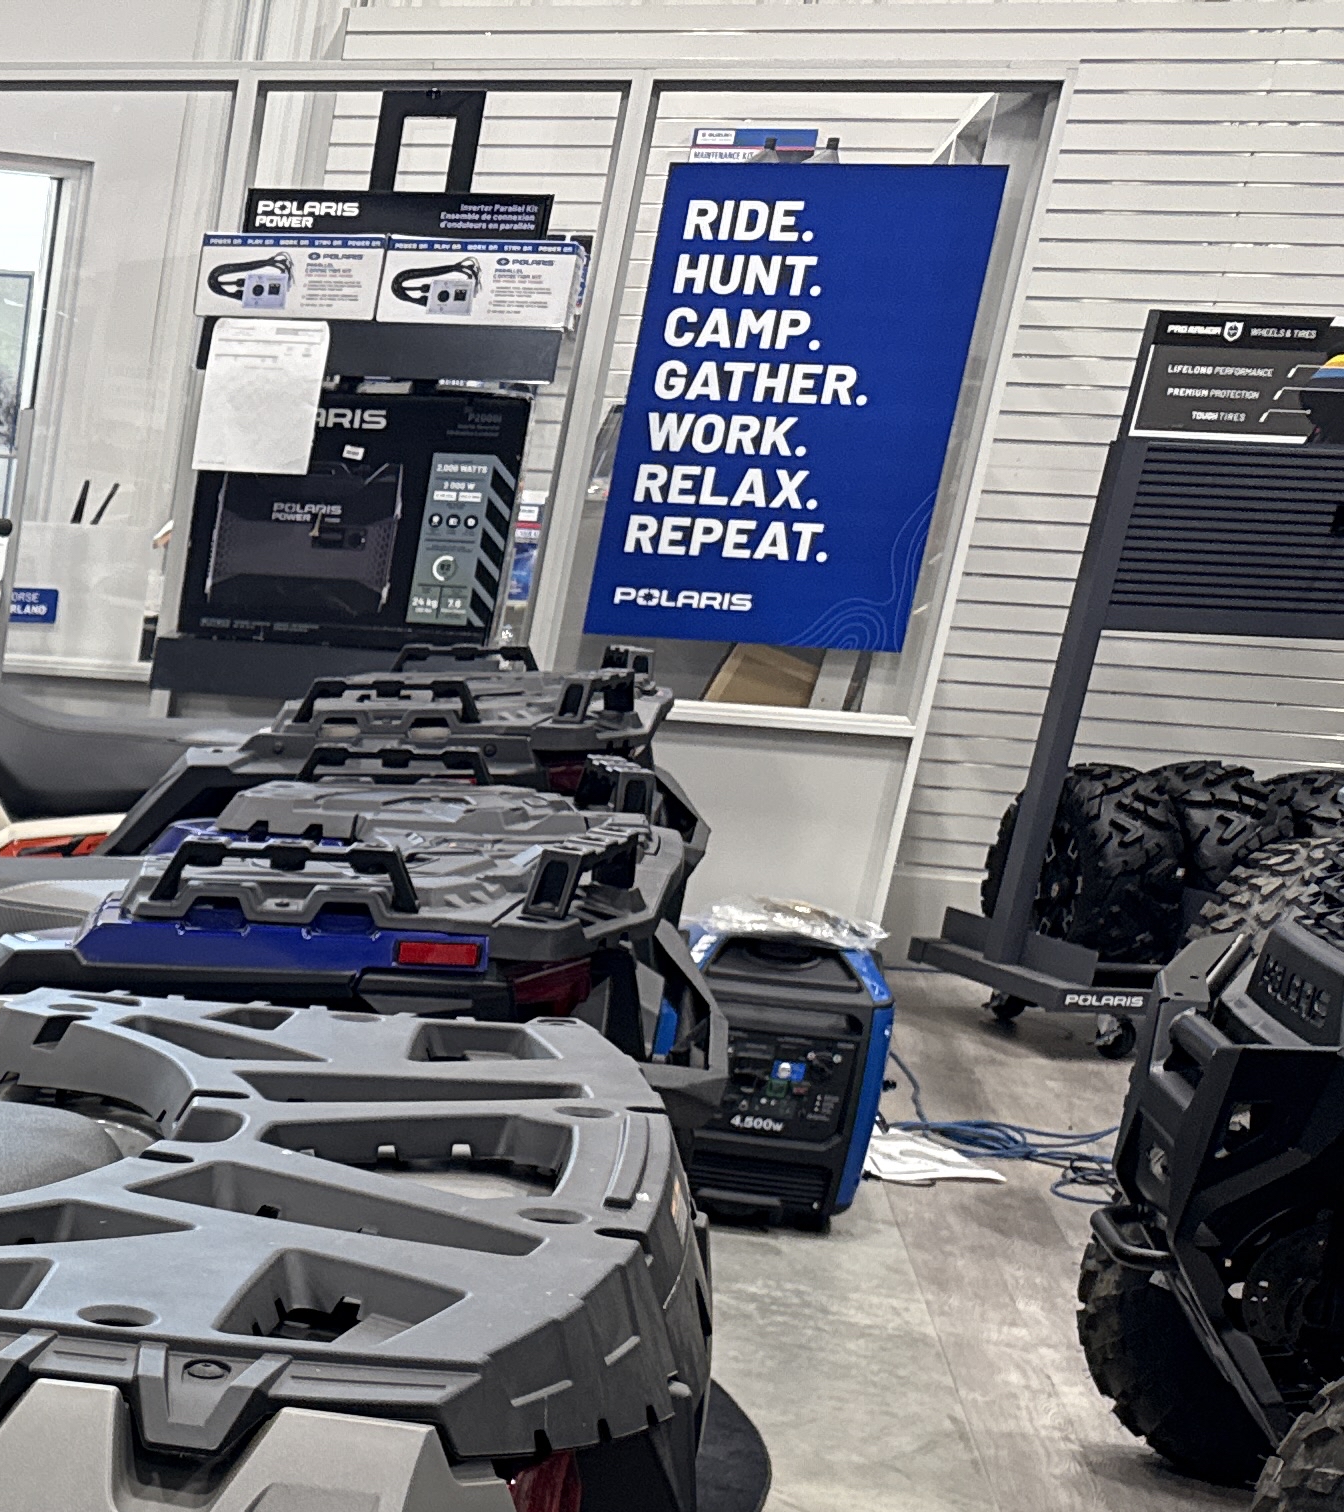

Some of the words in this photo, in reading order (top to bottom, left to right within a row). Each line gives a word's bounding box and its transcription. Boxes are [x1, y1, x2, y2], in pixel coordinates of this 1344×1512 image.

[694, 150, 740, 160] MAINTENANCE
[257, 201, 360, 217] POLARIS
[526, 204, 539, 214] Kit
[255, 216, 313, 229] POWER
[682, 199, 814, 242] RIDE.
[672, 253, 821, 297] HUNT.
[664, 306, 820, 351] CAMP.
[1293, 329, 1317, 339] TIRES
[1168, 365, 1213, 375] LIFELONG
[1214, 366, 1274, 378] PERFORMANCE
[654, 359, 868, 406] GATHER.
[1167, 388, 1208, 398] PREMIUM
[1210, 390, 1260, 400] PROTECTION
[316, 408, 387, 430] ARIS
[1192, 411, 1219, 421] TOUGH
[1220, 412, 1246, 422] TIRES
[648, 412, 807, 457] WORK.
[633, 463, 818, 510] RELAX.
[273, 502, 342, 516] POLARIS
[272, 512, 311, 522] POWER
[623, 514, 827, 563] REPEAT.
[613, 586, 752, 612] POLARIS
[1065, 993, 1144, 1008] POLARIS
